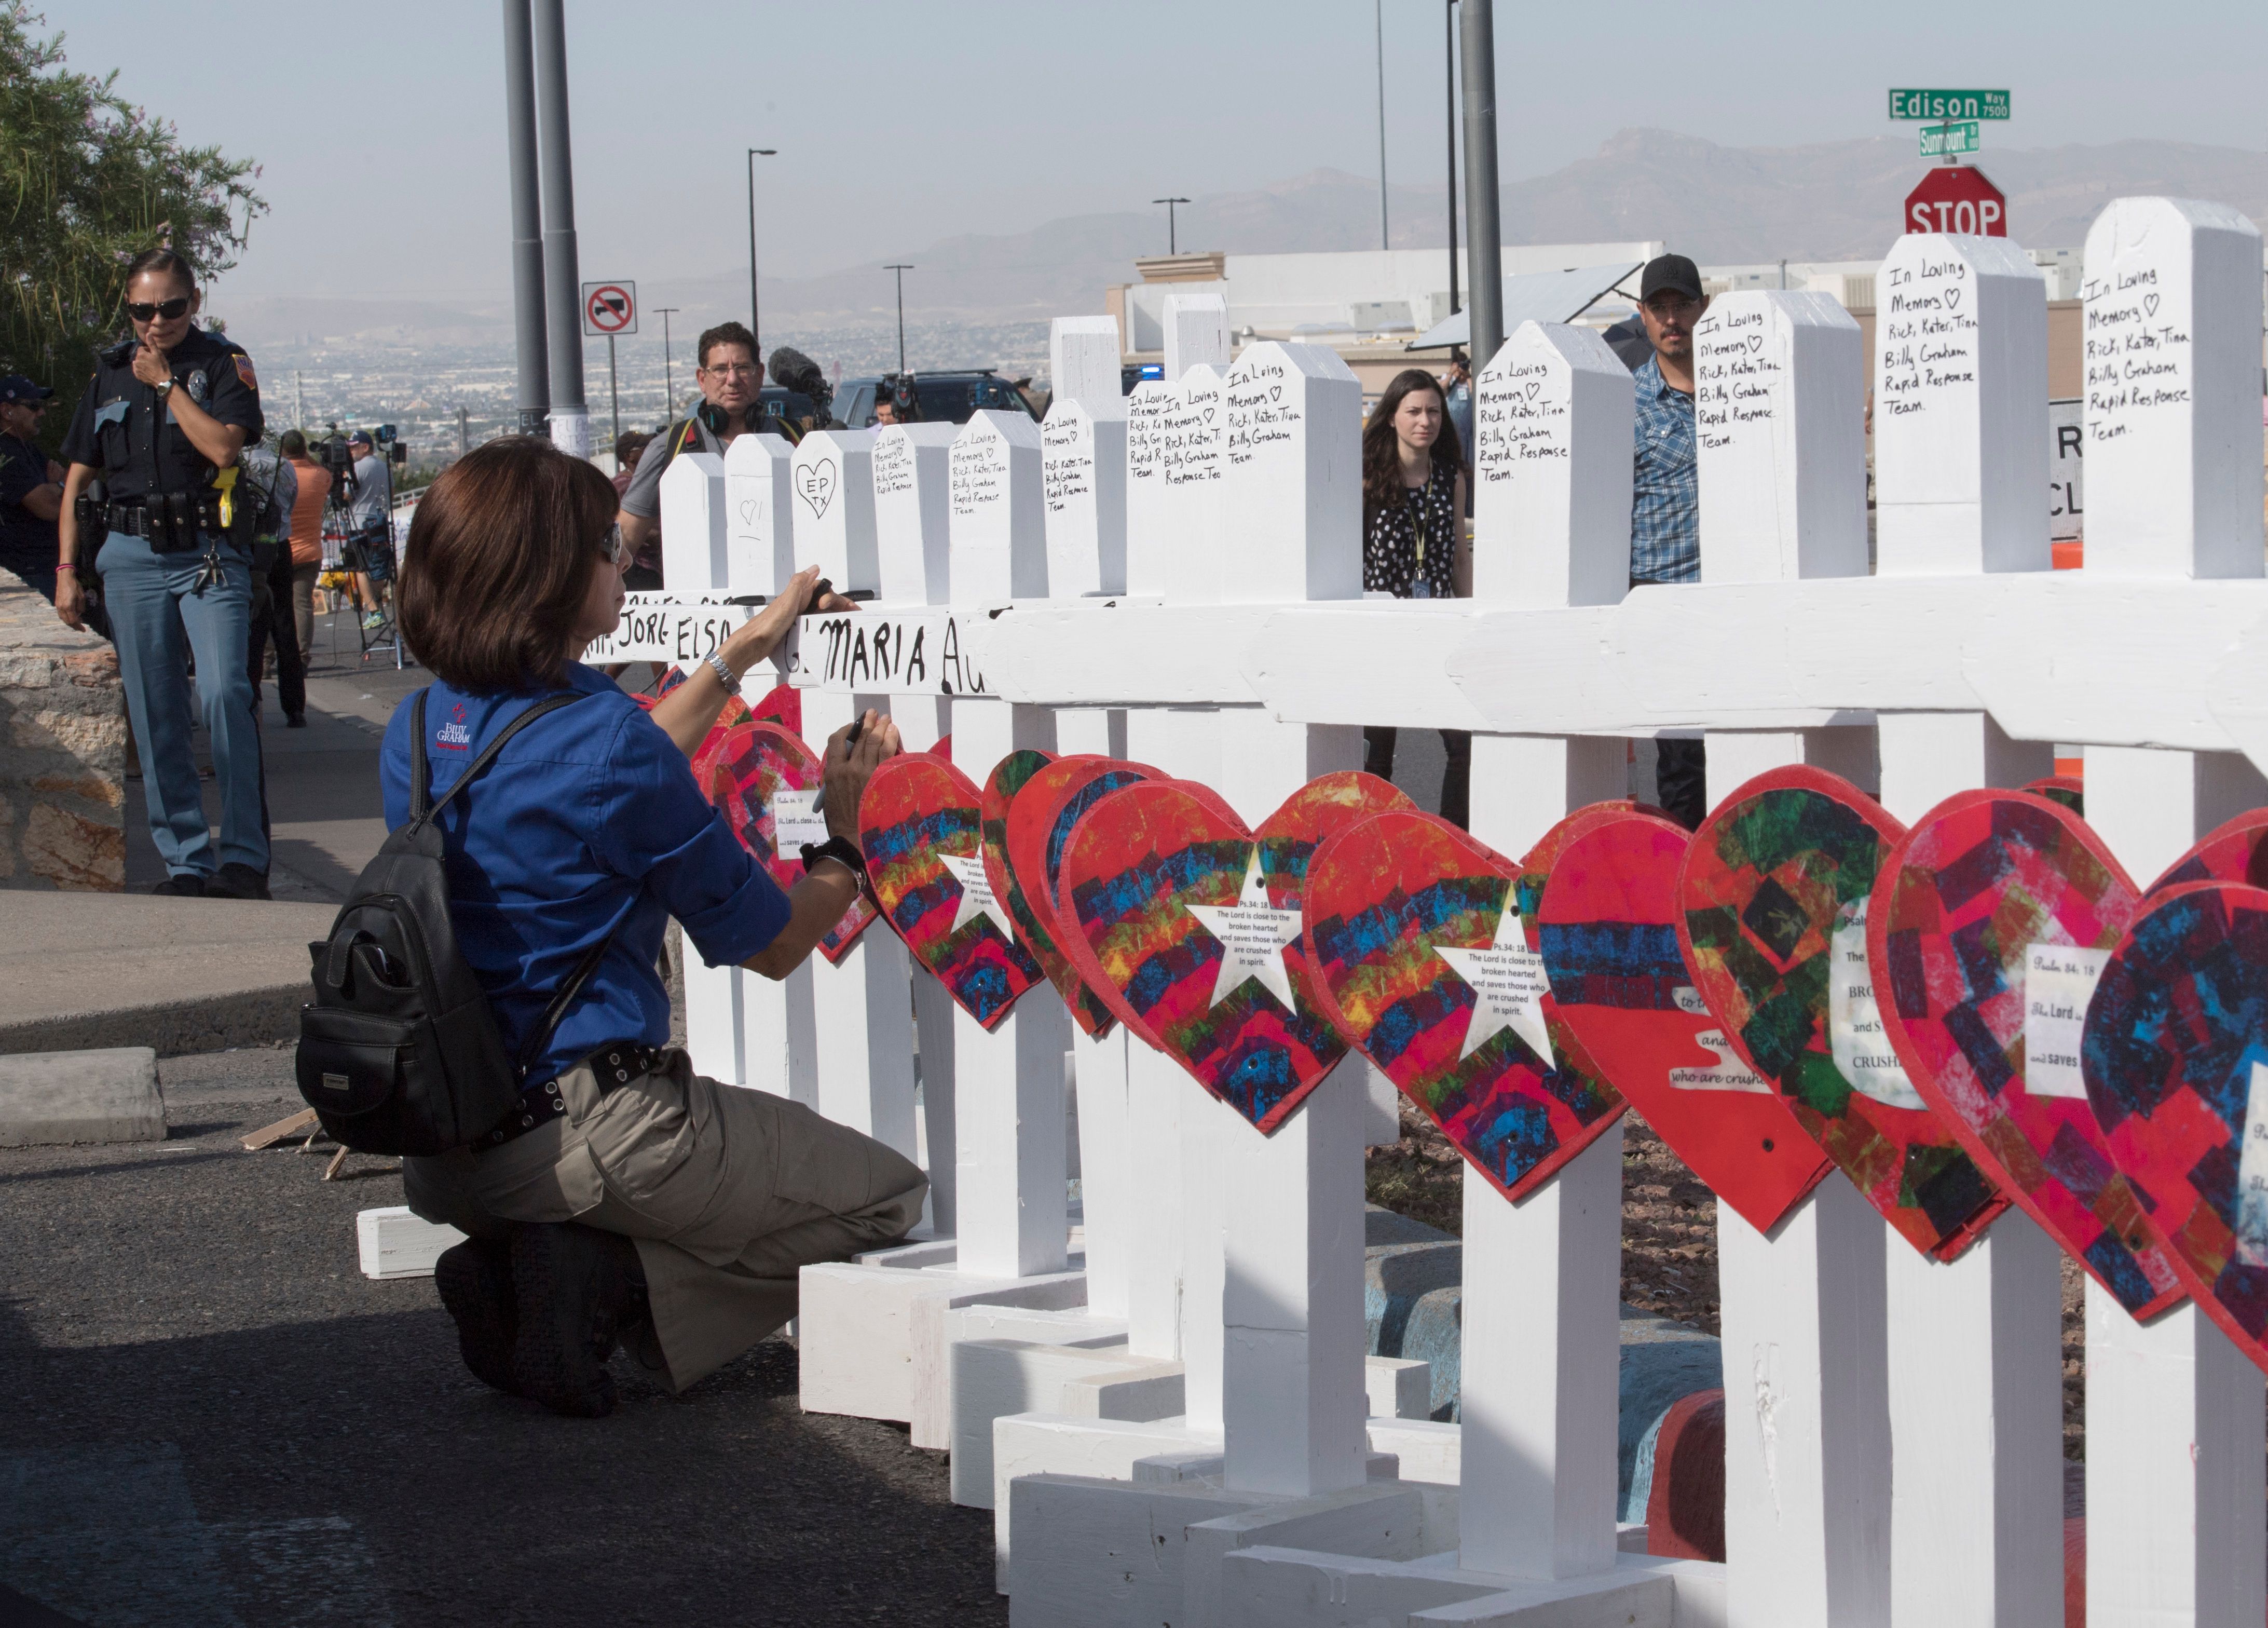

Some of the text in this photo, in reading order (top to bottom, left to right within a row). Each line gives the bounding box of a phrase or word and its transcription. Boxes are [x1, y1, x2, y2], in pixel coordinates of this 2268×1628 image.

[1892, 92, 2004, 116] Edison Way
[1983, 106, 2007, 116] 7500
[1912, 200, 2000, 236] STOP
[1890, 259, 1964, 286] In Loving
[2085, 270, 2156, 302] In Loving
[1892, 294, 1941, 313] Memory
[1699, 311, 1762, 335] In Loving
[1952, 315, 1977, 328] Tina
[2089, 308, 2141, 329] Memory
[2158, 327, 2190, 343] Tina
[1701, 343, 1746, 357] Memory
[1886, 343, 1967, 370] Billy Graham
[1757, 358, 1781, 370] Tina
[1228, 372, 1249, 388] In
[1482, 362, 1547, 383] In Loving
[2088, 360, 2177, 385] Billy Graham
[1886, 369, 1973, 394] Rapid Response
[1130, 396, 1142, 406] In
[1163, 389, 1218, 413] In Loving
[1228, 394, 1267, 408] Memory
[1480, 392, 1523, 404] Memory
[1700, 383, 1768, 404] Billy Graham
[2091, 387, 2190, 414] Rapid Response
[1278, 406, 1301, 422] Tina
[1539, 401, 1564, 416] Tina
[1044, 417, 1076, 431] In Loving
[1165, 416, 1202, 430] Memory
[1699, 409, 1728, 427] Rapid
[875, 436, 904, 451] In Loving
[952, 433, 995, 450] In Loving
[1045, 437, 1069, 446] Memory
[1130, 433, 1147, 449] Billy
[1228, 428, 1290, 448] Billy Graham
[1480, 426, 1552, 447] Billy Graham
[875, 452, 897, 463] Memory
[954, 453, 983, 463] Memory
[1131, 451, 1152, 465] Rapid
[1165, 452, 1183, 469] Billy
[1185, 451, 1218, 463] Graham
[1480, 444, 1567, 464] Rapid Response
[990, 463, 1006, 472] Tina
[1078, 458, 1091, 467] Tina
[877, 473, 888, 484] Billy
[1046, 472, 1060, 487] Billy
[1166, 470, 1205, 485] Response
[808, 478, 828, 493] EP
[953, 478, 996, 493] Billy Graham
[812, 496, 826, 507] TX
[954, 492, 999, 505] Rapid Response
[819, 618, 924, 688] MARIA
[437, 730, 470, 743] GRAHAM
[446, 723, 467, 737] BILLY
[1494, 943, 1514, 952] Ps.34:
[1247, 958, 1265, 967] spirit.
[1484, 955, 1498, 963] Lord
[1509, 956, 1526, 965] close
[1847, 952, 1864, 962] The
[1482, 967, 1536, 978] broken hearted
[2034, 956, 2094, 976] Psalm 18
[1500, 994, 1528, 1002] crushed
[1502, 1006, 1522, 1015] spirit.
[2032, 1002, 2073, 1019] The Lord
[1853, 1022, 1871, 1033] and
[2031, 1053, 2076, 1067] and saves
[1672, 1070, 1724, 1082] who are
